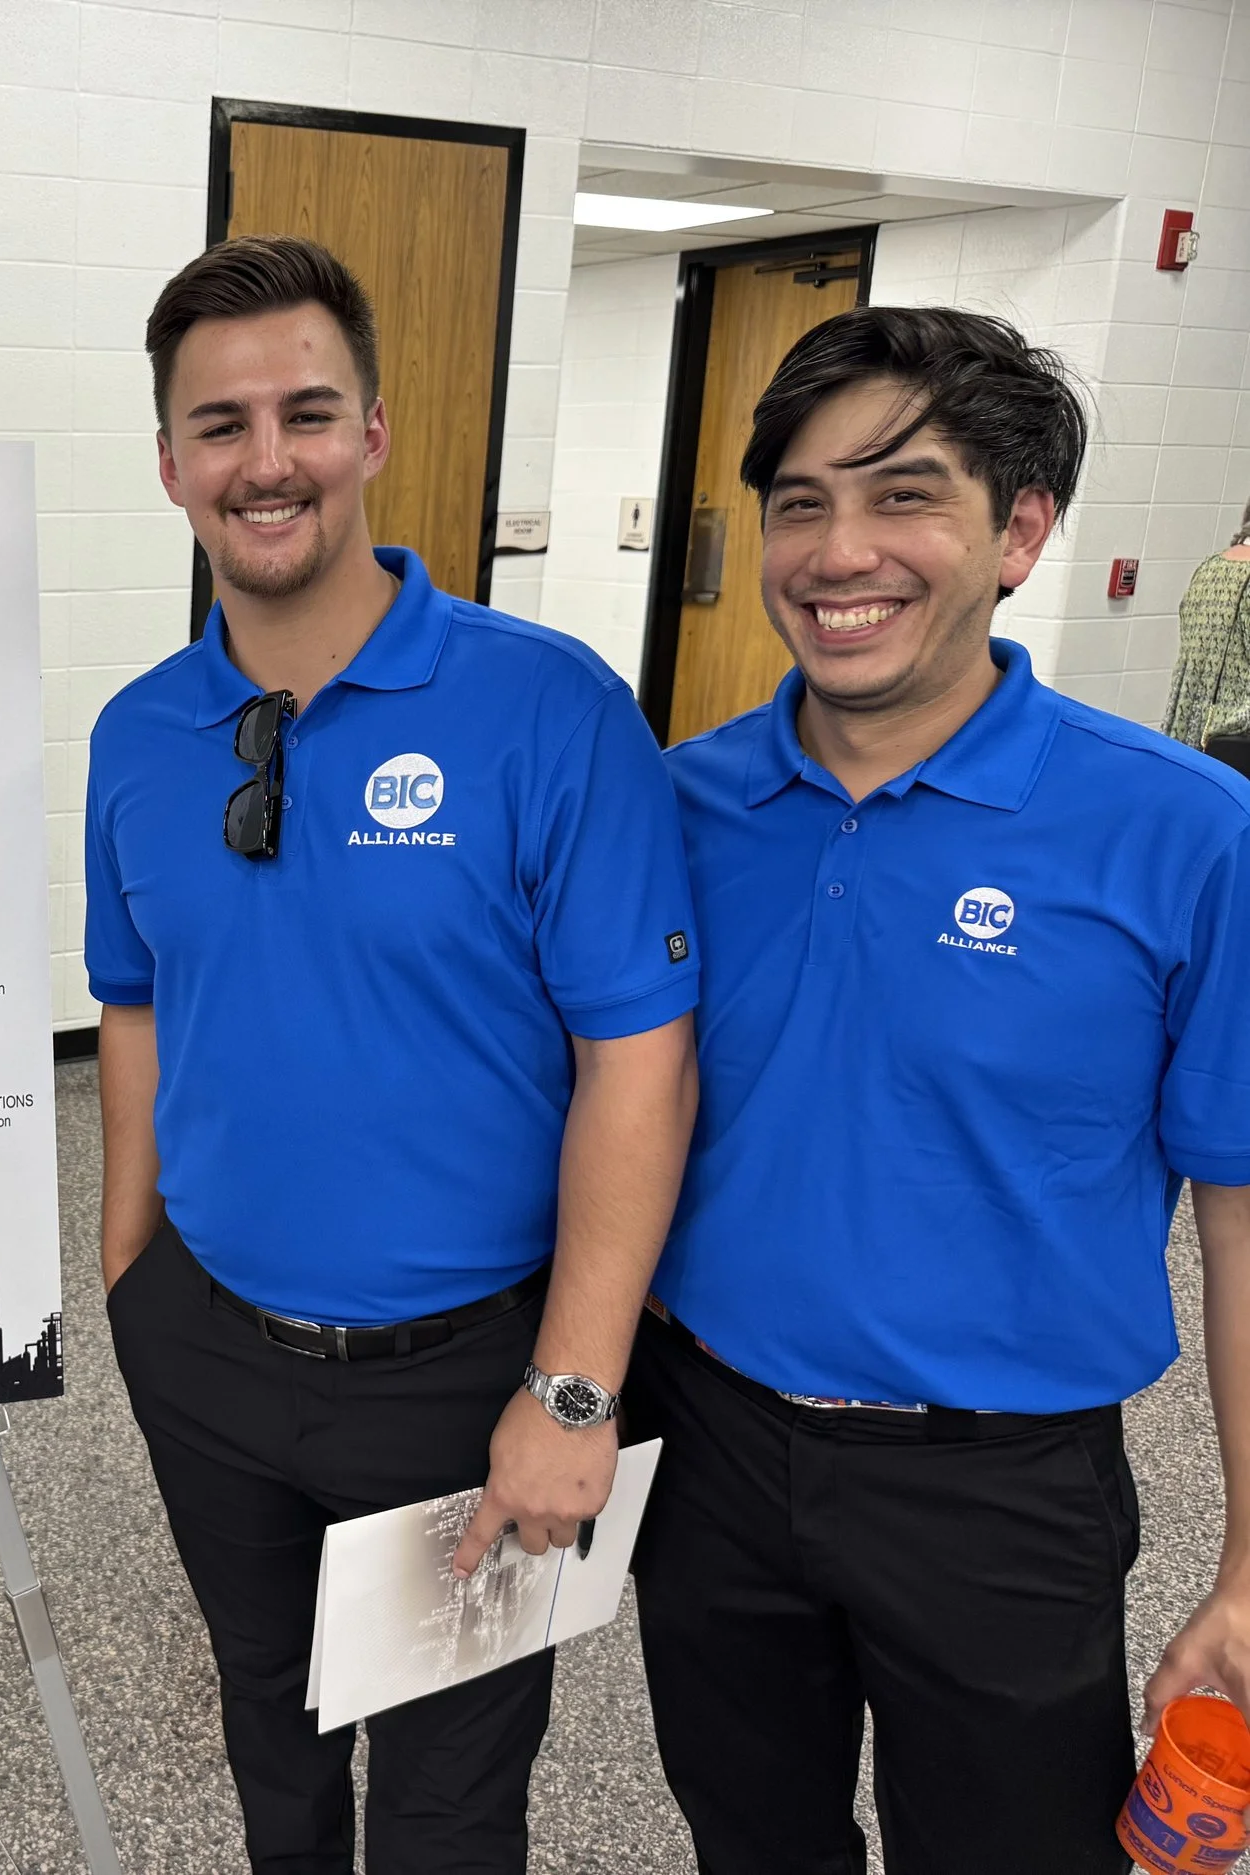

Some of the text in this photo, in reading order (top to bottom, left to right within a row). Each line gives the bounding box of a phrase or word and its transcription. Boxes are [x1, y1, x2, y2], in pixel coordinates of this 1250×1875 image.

[370, 774, 439, 810] BIC
[348, 831, 456, 846] ALLIANCE
[958, 897, 1011, 929] BIC
[937, 933, 1018, 956] ALLIANCE
